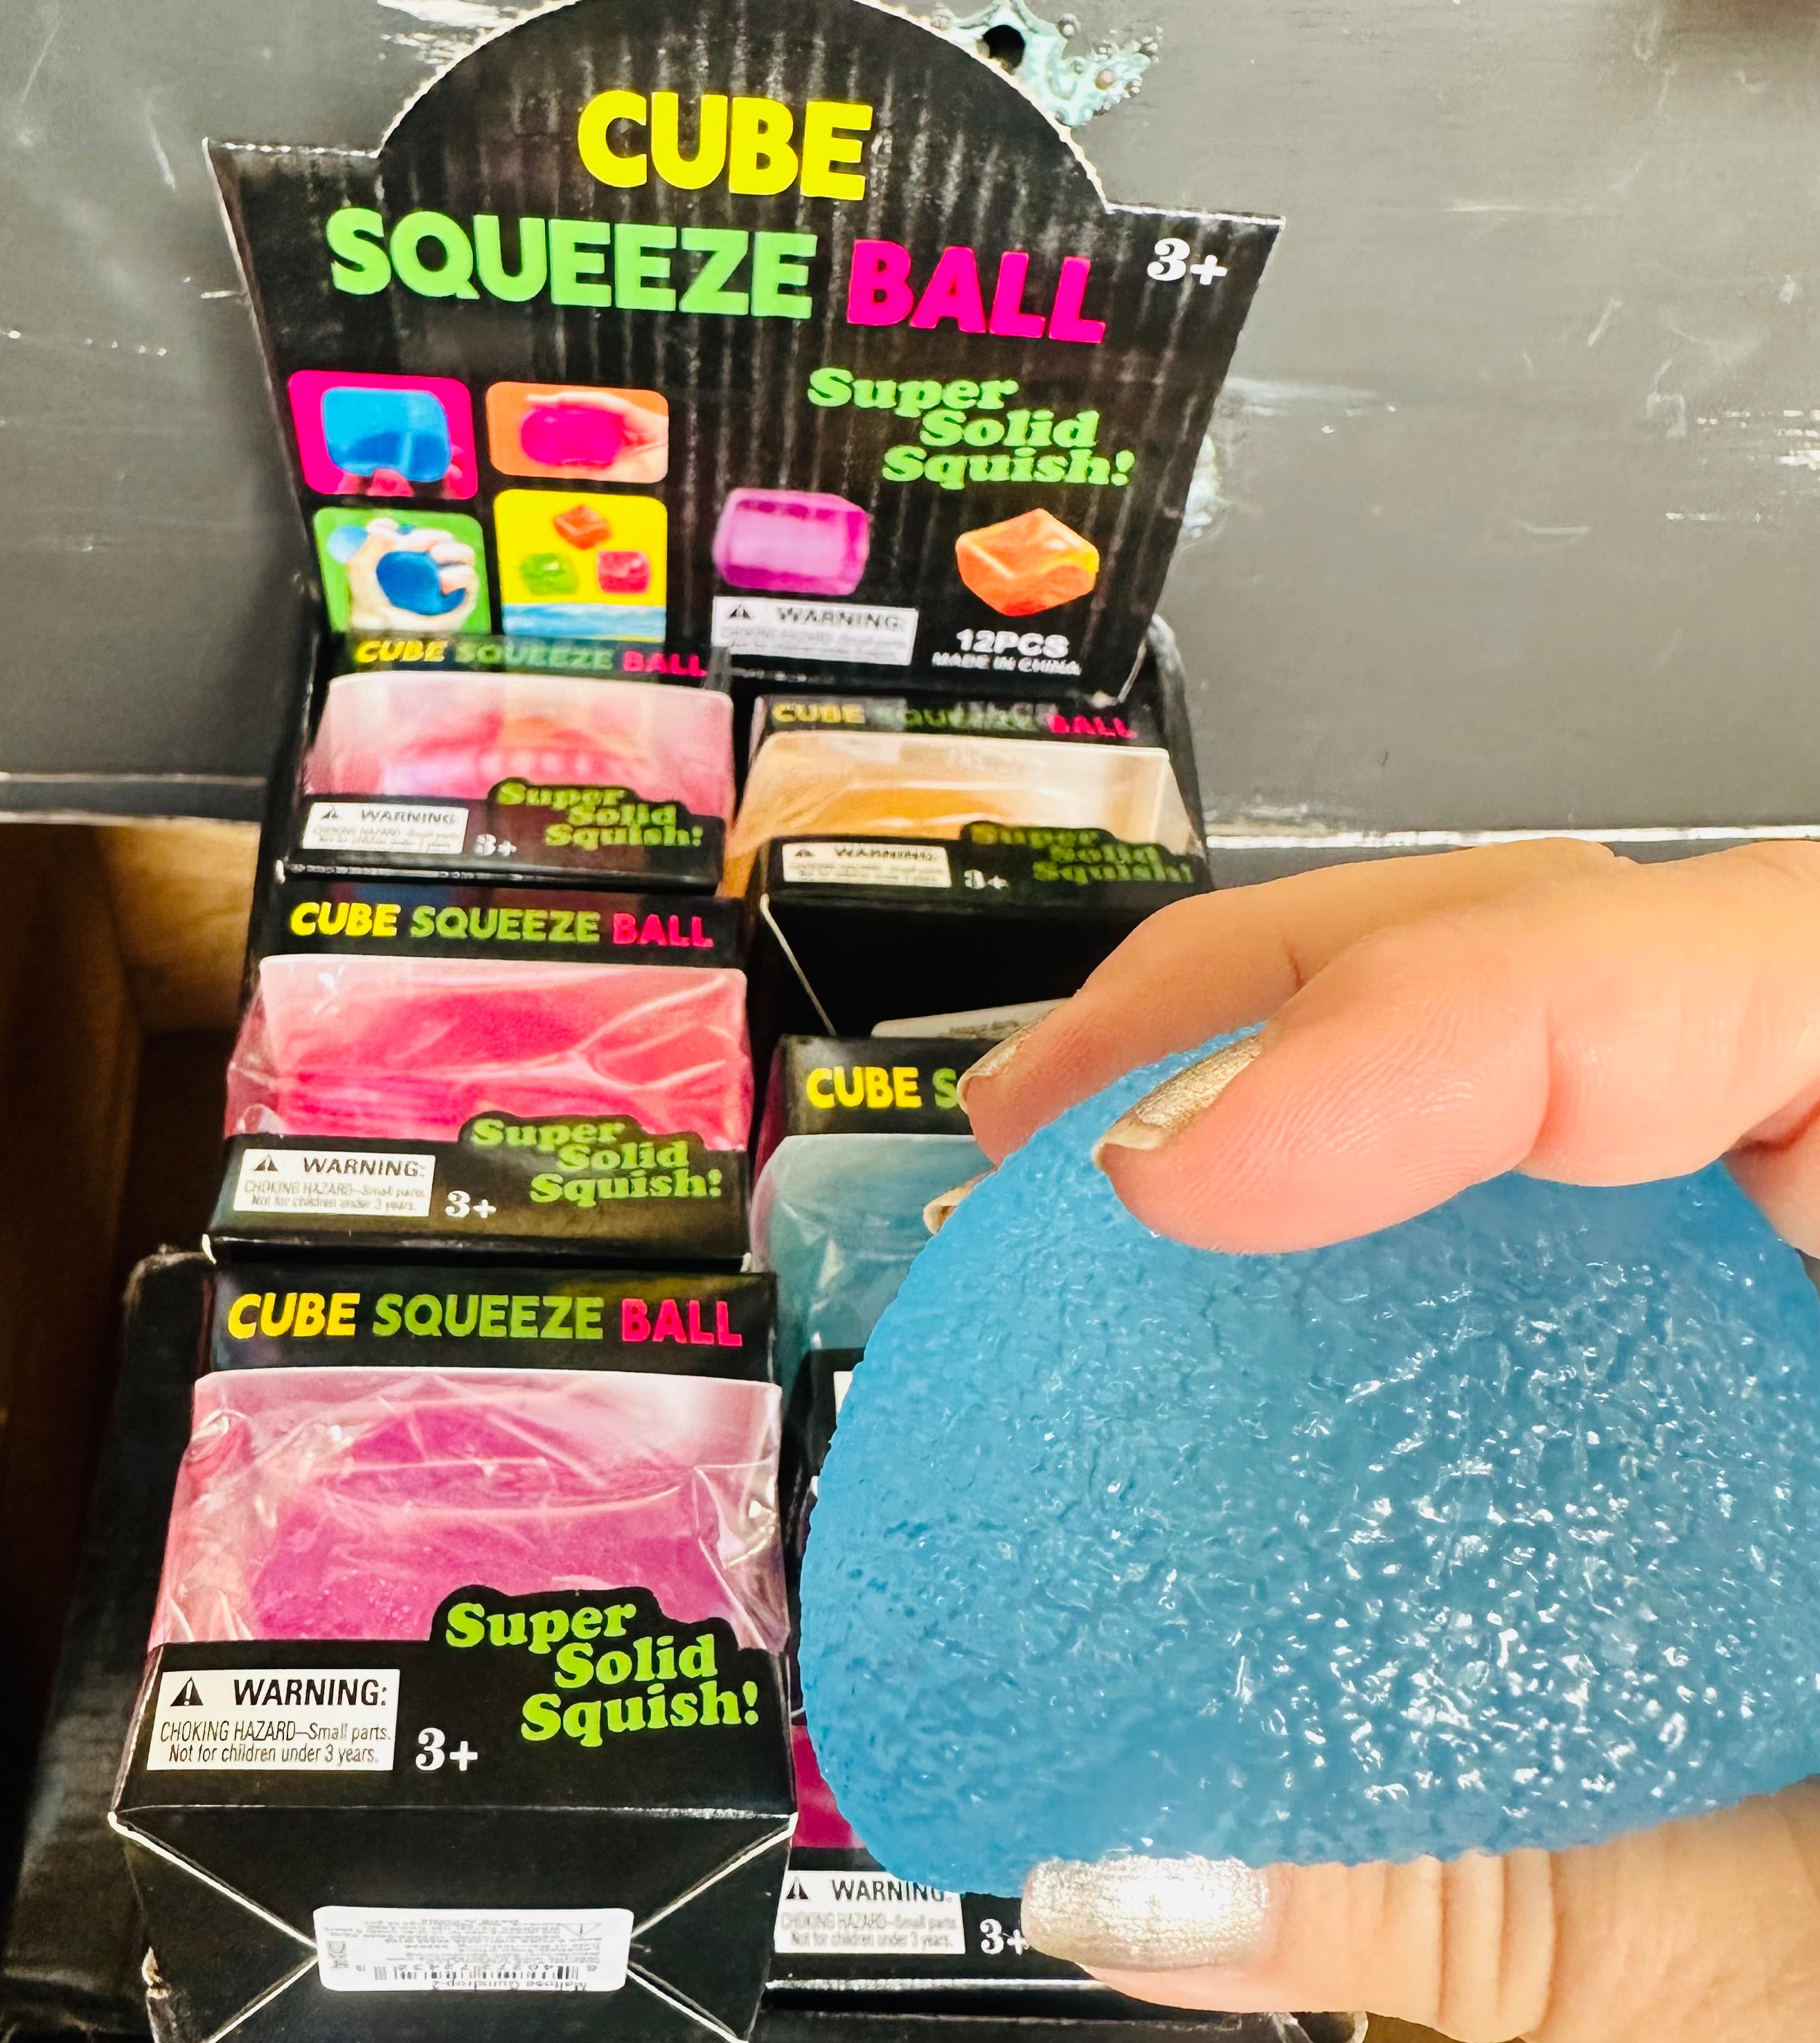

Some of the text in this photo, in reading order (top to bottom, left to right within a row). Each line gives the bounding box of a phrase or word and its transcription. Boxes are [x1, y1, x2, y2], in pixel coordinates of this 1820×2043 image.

[578, 89, 873, 201] CUBE
[325, 207, 1107, 344] SQUEEZE BALL
[1147, 238, 1228, 285] 3+
[808, 366, 1019, 418] Super
[920, 409, 1100, 448] Solid
[882, 445, 1136, 490] Squish!
[355, 639, 707, 677] CUBE SQUEEZE BALL
[956, 628, 1069, 659] 12PCS
[931, 652, 1082, 676] MADE IN CHINA
[497, 782, 626, 810] Super
[568, 802, 677, 826] Solid
[474, 833, 517, 857] 3+
[544, 823, 704, 851] Squish!
[964, 869, 1008, 889] 3+
[290, 902, 714, 948] CUBE SQUEEZE BALL
[806, 1067, 922, 1109] CUBE
[471, 1118, 625, 1152] Super
[556, 1141, 690, 1171] Solid
[445, 1190, 497, 1218] 3+
[529, 1168, 722, 1208] Squish!
[227, 1292, 743, 1347] CUBE SQUEEZE BALL
[445, 1603, 636, 1654] Super
[555, 1633, 717, 1688] Solid
[233, 1679, 386, 1706] WARNING:
[161, 1720, 229, 1742] CHOKING
[351, 1724, 391, 1744] parts.
[521, 1680, 758, 1747] Squish!
[169, 1743, 378, 1767] Not for children under 3 years.
[416, 1727, 478, 1772] 3+
[980, 1918, 1029, 1955] 3+
